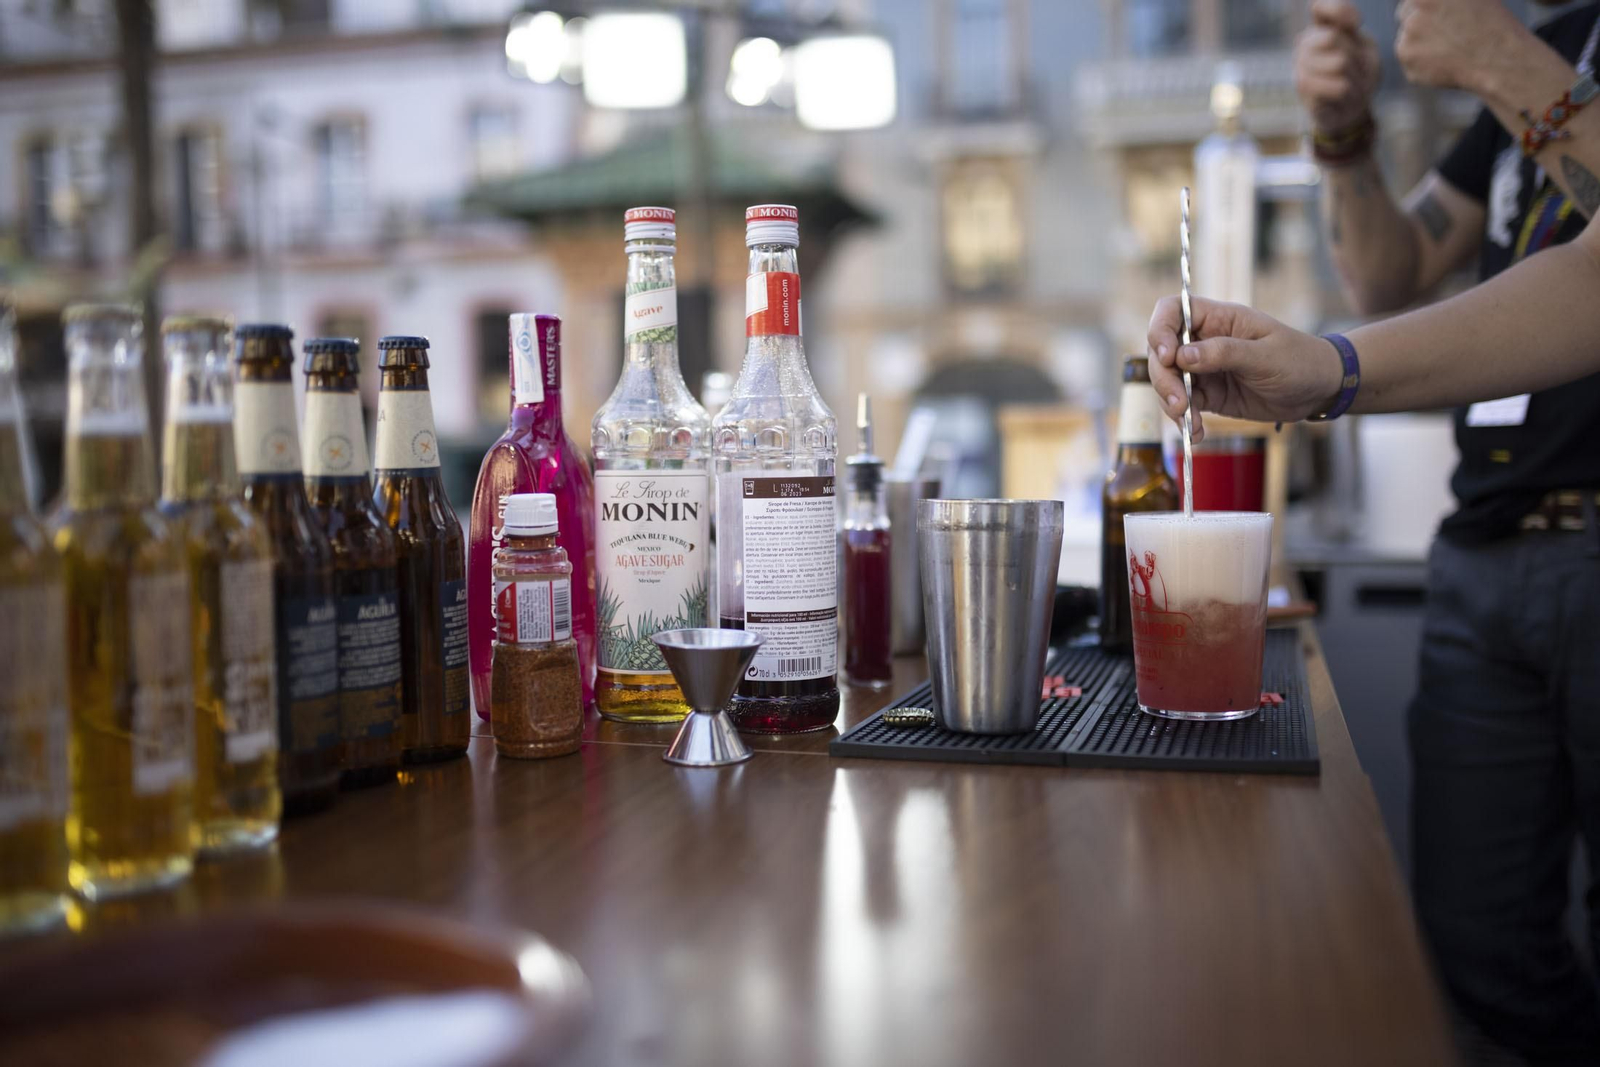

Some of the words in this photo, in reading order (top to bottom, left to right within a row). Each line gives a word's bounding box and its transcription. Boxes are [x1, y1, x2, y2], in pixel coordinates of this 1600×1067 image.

[633, 209, 674, 220] MONIN
[760, 208, 798, 218] MONIN
[633, 305, 663, 318] Agave
[546, 326, 556, 385] MASTER'S
[610, 481, 630, 498] Le
[633, 480, 672, 502] Sirop
[676, 487, 690, 498] de
[602, 502, 698, 522] MONIN
[610, 533, 646, 549] TEQUILANA
[648, 533, 668, 541] BLUE
[615, 554, 648, 569] AGAVE
[649, 554, 685, 568] SUGAR
